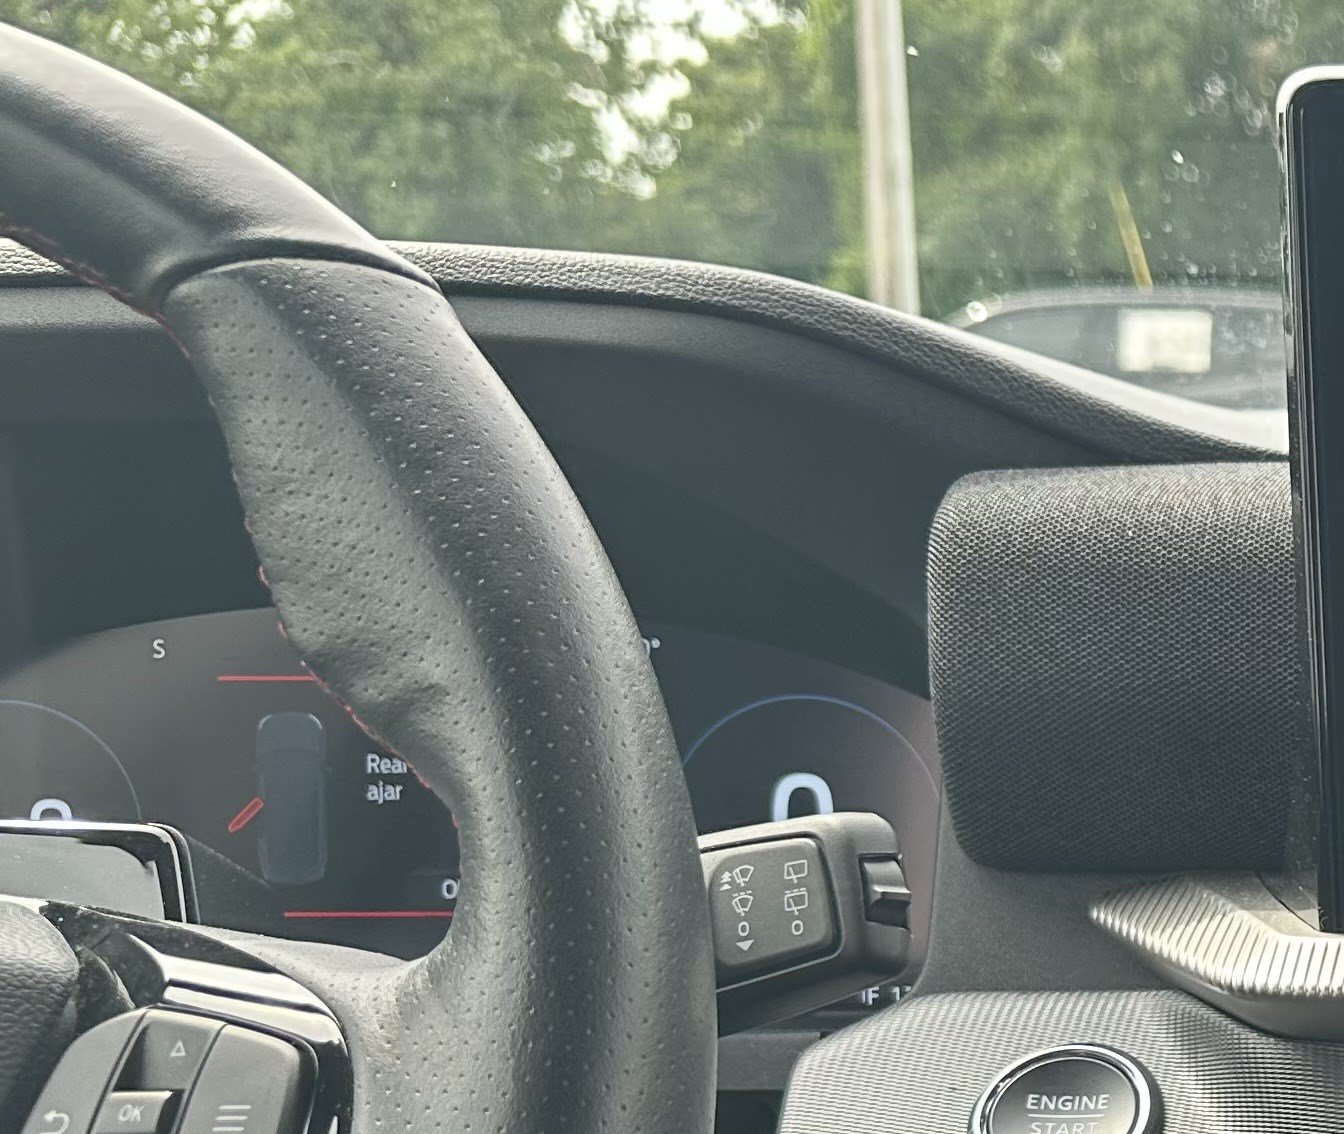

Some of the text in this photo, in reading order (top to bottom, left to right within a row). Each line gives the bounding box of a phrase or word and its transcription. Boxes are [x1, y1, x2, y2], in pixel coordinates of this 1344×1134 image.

[152, 638, 166, 660] S
[366, 780, 403, 805] ajar
[1025, 1093, 1111, 1112] ENGINE
[117, 1104, 145, 1122] OK
